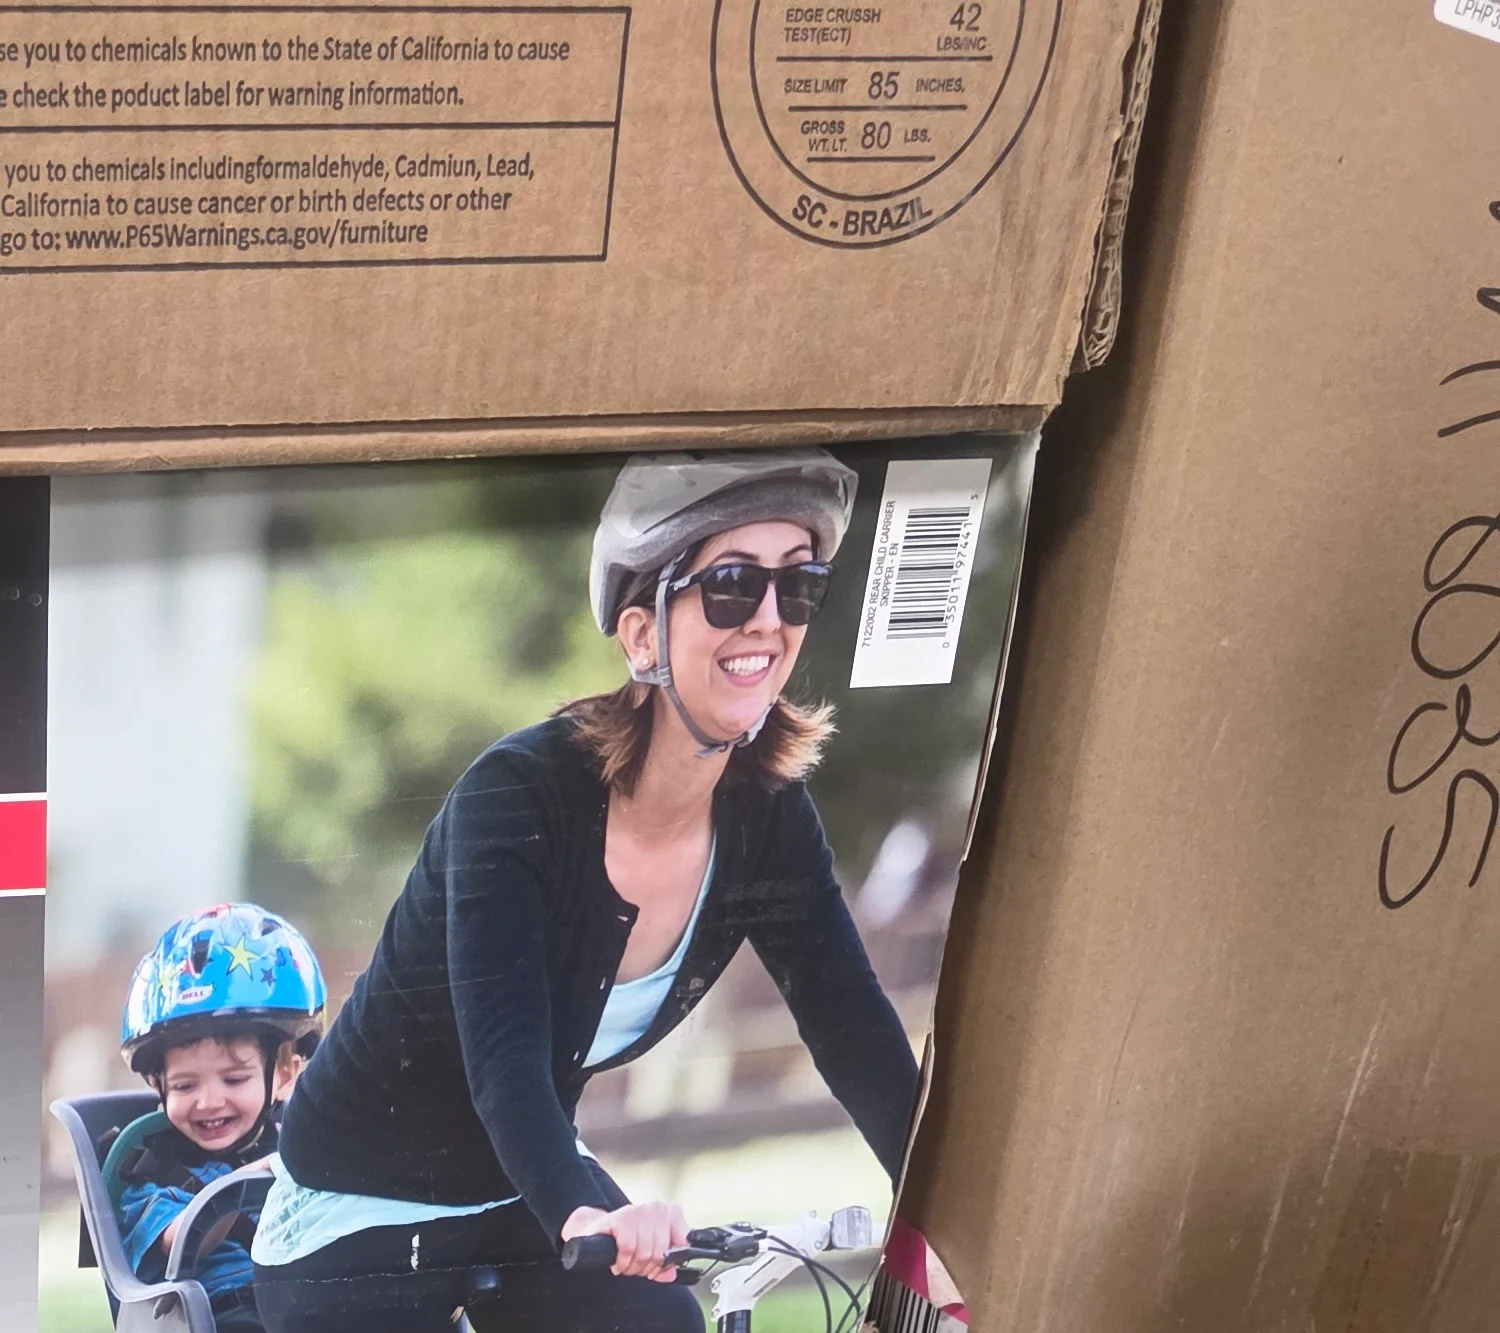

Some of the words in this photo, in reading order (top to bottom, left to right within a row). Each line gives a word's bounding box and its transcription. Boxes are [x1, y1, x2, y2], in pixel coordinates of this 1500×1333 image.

[785, 7, 824, 23] EDGE
[826, 7, 882, 23] CRUSSH
[950, 2, 982, 33] 42
[784, 26, 852, 45] TEST(ECT)
[23, 42, 61, 69] you
[65, 38, 87, 62] to
[91, 35, 187, 62] chemicals
[191, 35, 256, 62] known
[261, 38, 282, 62] to
[287, 35, 319, 61] the
[322, 36, 373, 61] State
[377, 35, 399, 61] of
[401, 35, 489, 61] California
[493, 38, 514, 61] to
[517, 41, 571, 61] cause
[12, 81, 70, 109] check
[73, 81, 107, 108] the
[111, 81, 180, 114] poduct
[184, 80, 231, 107] label
[235, 80, 265, 107] for
[267, 81, 345, 111] warning
[349, 79, 465, 106] information.
[784, 77, 812, 94] SIZE
[813, 77, 848, 94] LIMIT
[867, 70, 900, 100] 85
[915, 77, 966, 94] INCHES.
[800, 119, 846, 136] GROSS
[860, 121, 892, 150] 80
[903, 127, 932, 144] LBS.
[4, 163, 41, 189] you
[45, 159, 67, 183] to
[72, 155, 166, 182] chemicals
[170, 153, 390, 185] includingformaldehyde,
[395, 152, 482, 182] Cadmiun,
[486, 151, 535, 181] Lead,
[1, 191, 100, 218] California
[105, 194, 128, 216] to
[133, 196, 193, 216] cause
[197, 195, 267, 215] cancer
[270, 194, 295, 214] or
[298, 188, 347, 213] birth
[352, 187, 425, 212] defects
[429, 192, 453, 211] or
[455, 186, 513, 211] other
[791, 194, 827, 229] SC
[842, 196, 933, 236] BRAZIL
[0, 232, 27, 257] go
[30, 228, 61, 251] to:
[64, 218, 429, 251] www.P65Warnings.ca.gov/furniture
[880, 500, 896, 543] CARRIER
[876, 546, 888, 576] CHILD
[879, 566, 894, 608] SKIPPER
[890, 542, 898, 556] EN
[869, 576, 881, 605] REAR
[861, 606, 877, 648] 7122002
